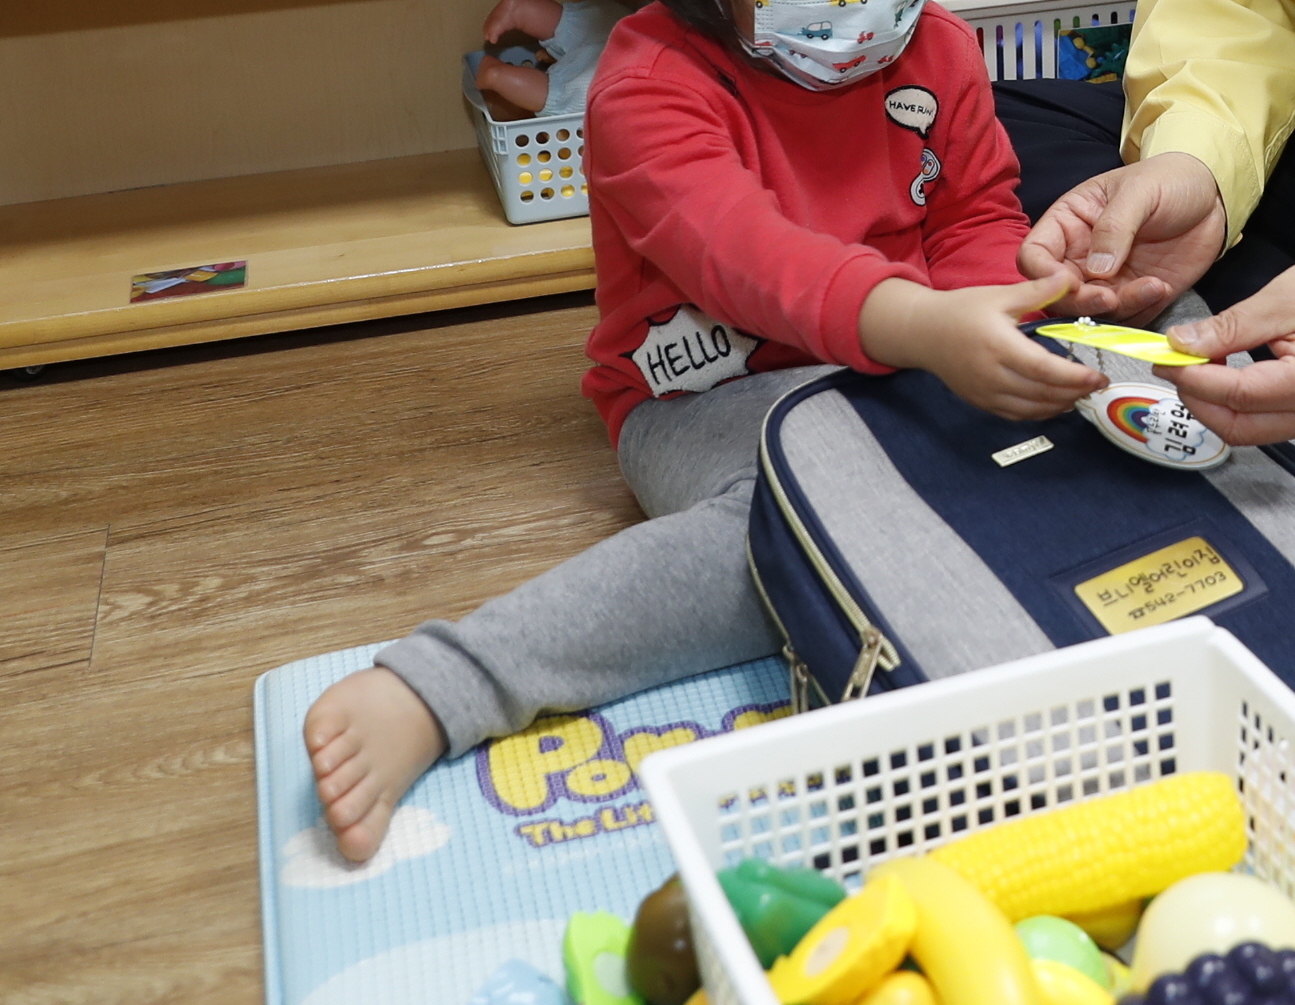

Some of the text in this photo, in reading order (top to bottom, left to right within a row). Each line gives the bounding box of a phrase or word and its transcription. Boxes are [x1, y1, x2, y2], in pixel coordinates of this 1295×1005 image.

[889, 100, 916, 113] HAVE
[646, 324, 732, 385] HELLO
[1096, 546, 1221, 607] 브니엘어린이집
[516, 818, 599, 847] The
